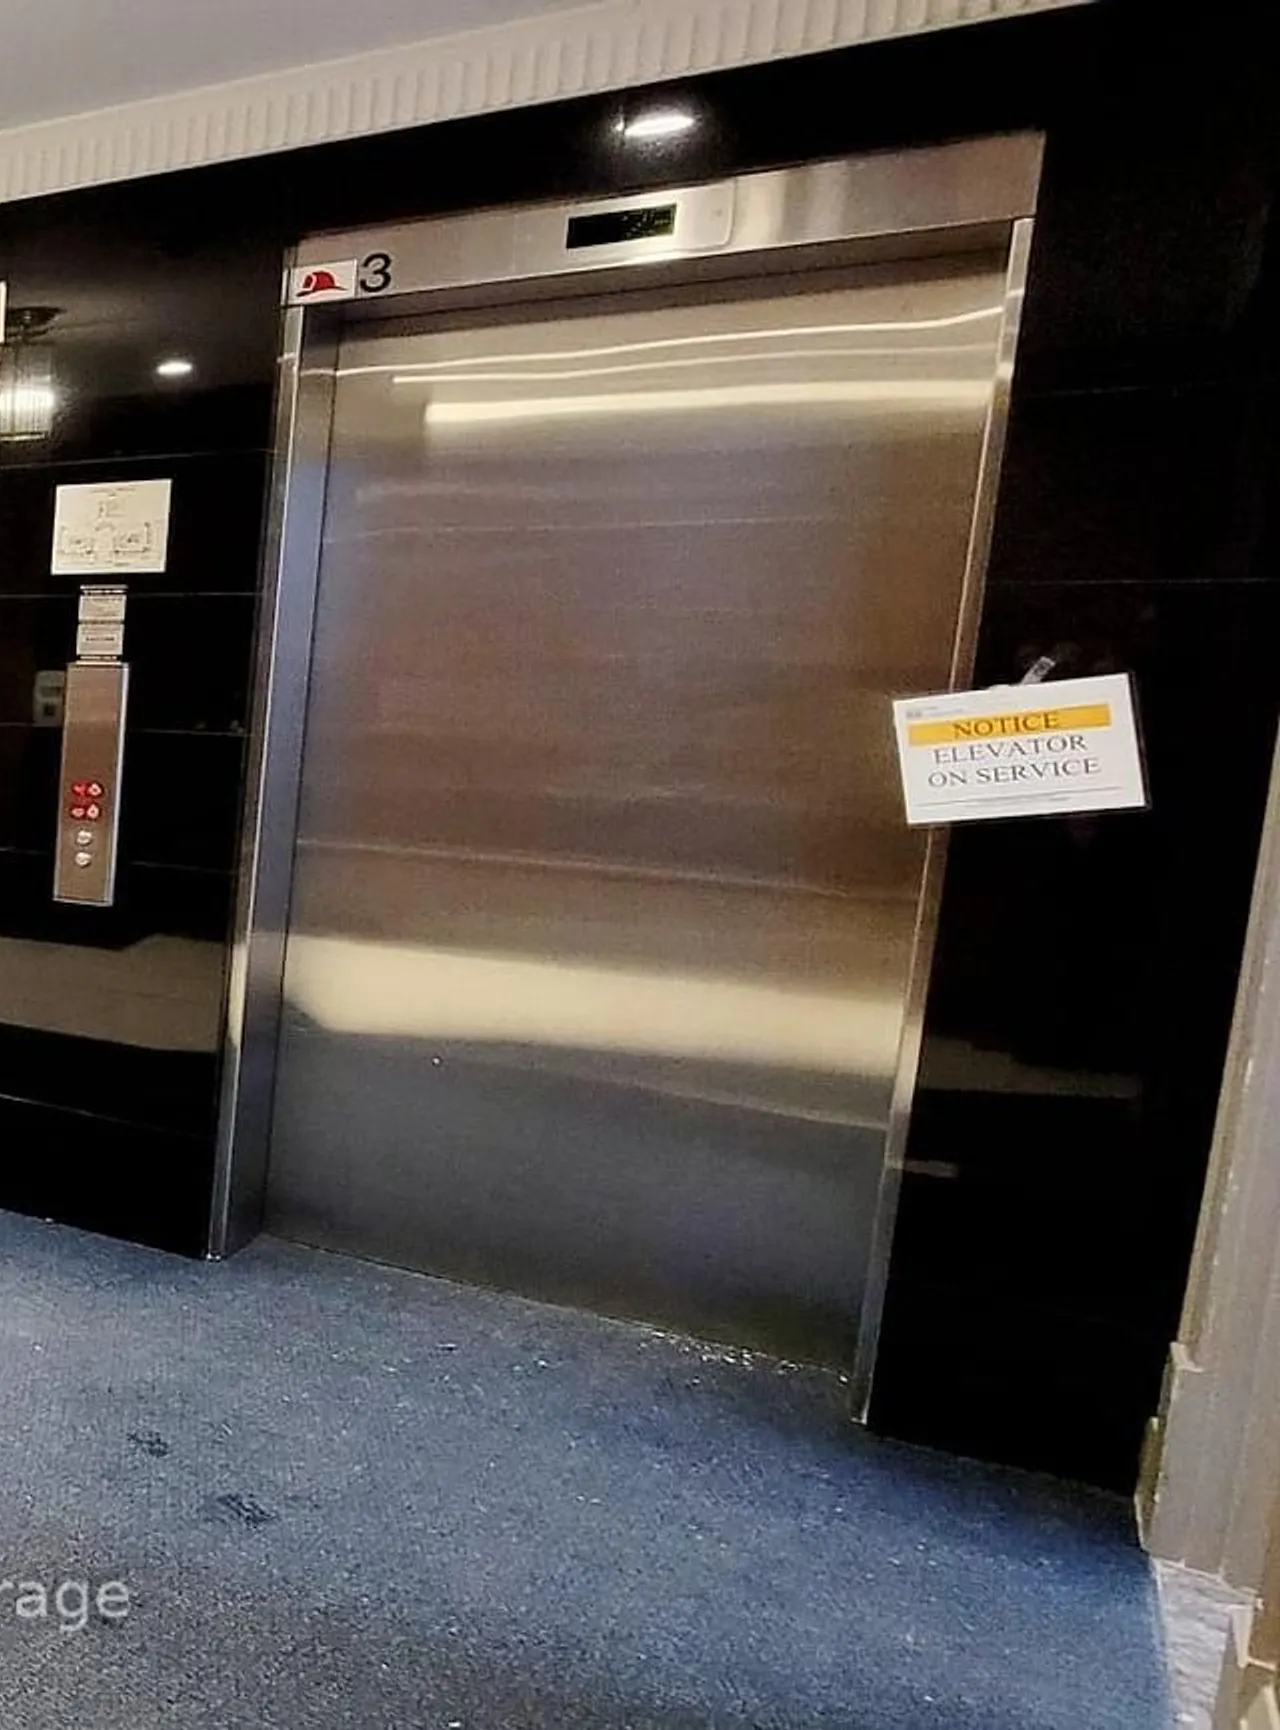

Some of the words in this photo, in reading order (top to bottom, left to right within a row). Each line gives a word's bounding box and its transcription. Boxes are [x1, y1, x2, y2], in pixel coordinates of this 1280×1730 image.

[359, 252, 392, 293] 3
[953, 710, 1060, 739] NOTICE
[934, 733, 1088, 764] ELEVATOR
[928, 769, 967, 788] ON
[977, 756, 1102, 784] SERVICE
